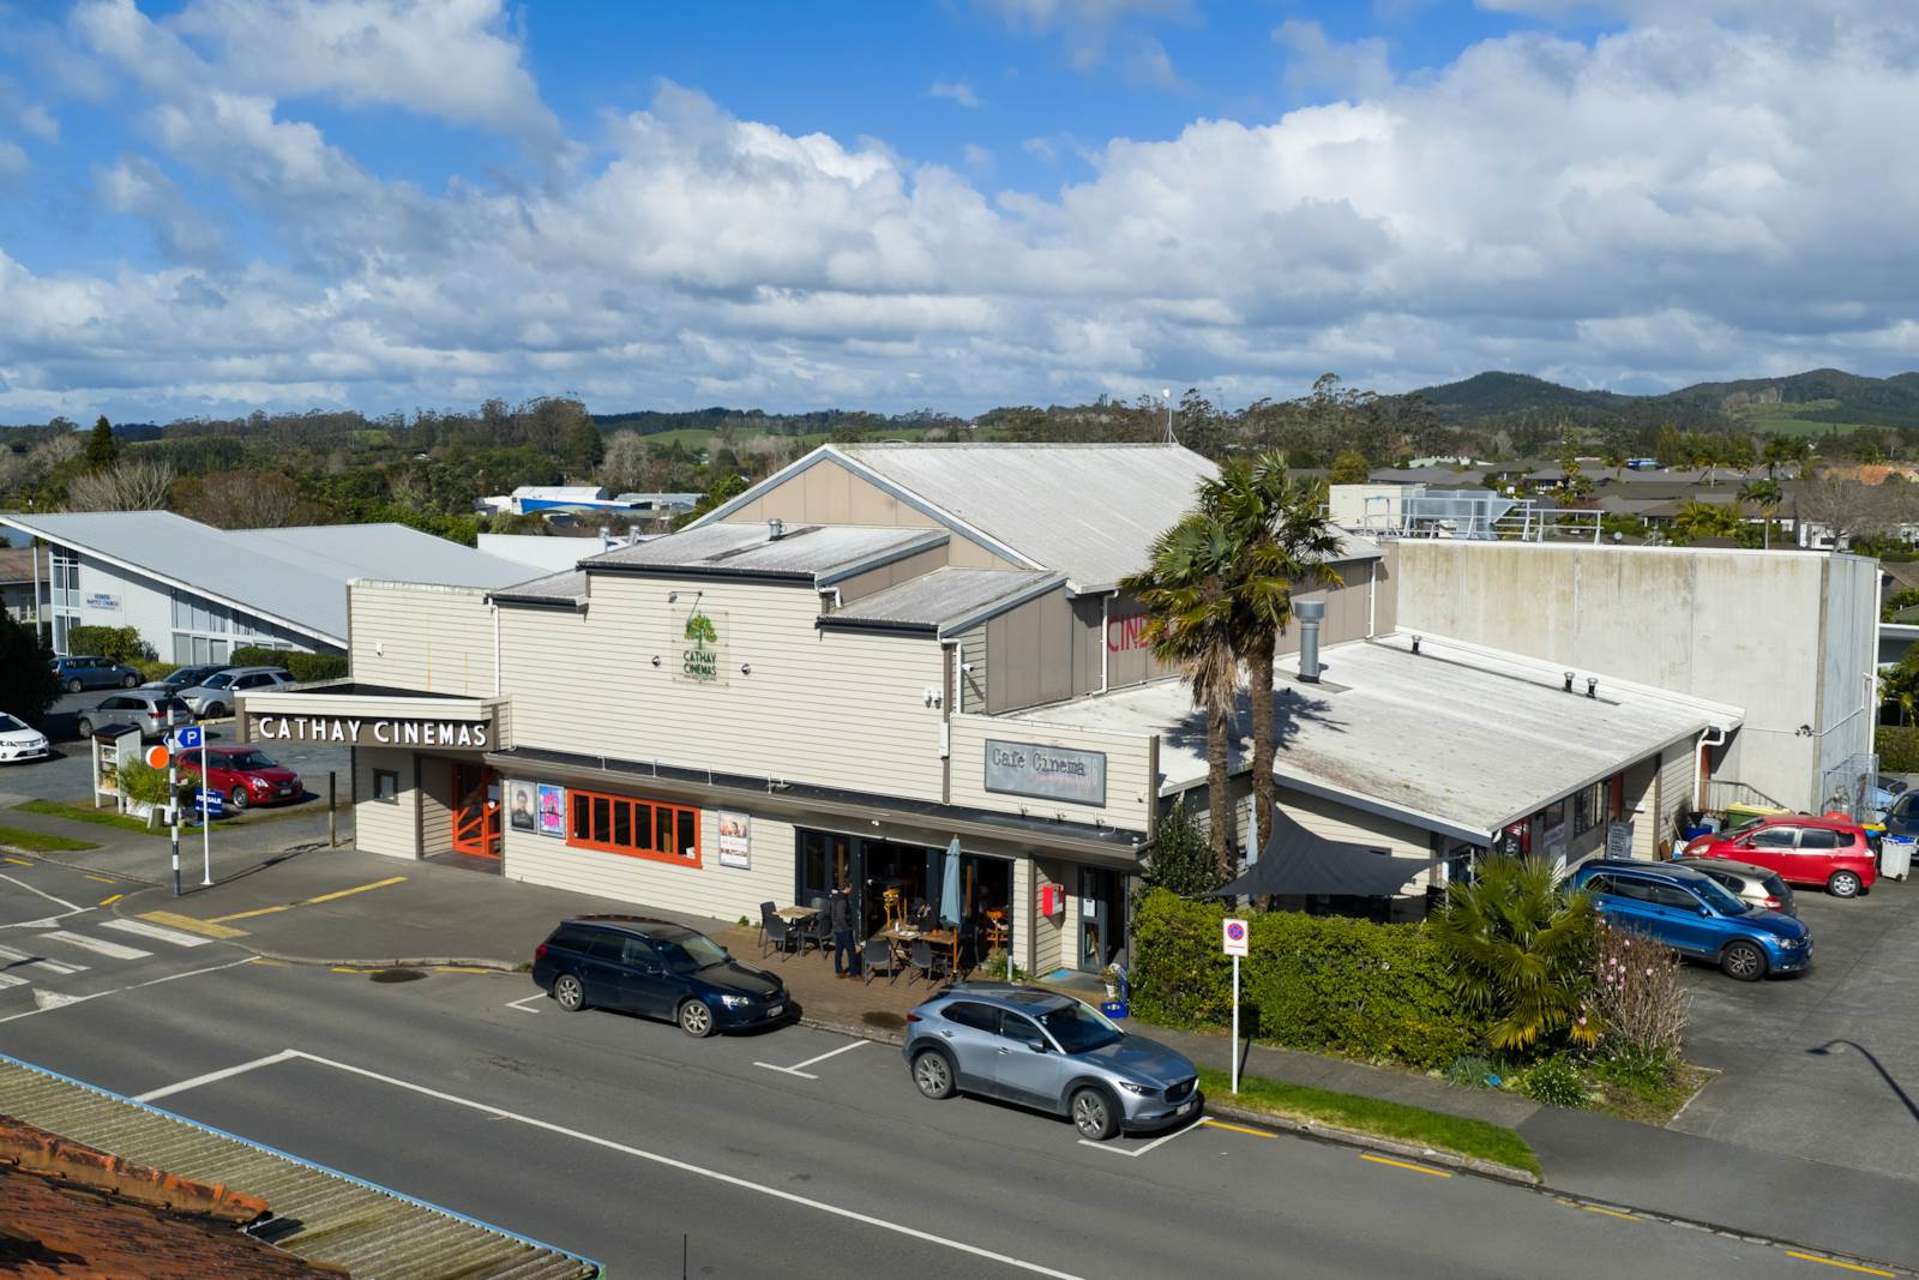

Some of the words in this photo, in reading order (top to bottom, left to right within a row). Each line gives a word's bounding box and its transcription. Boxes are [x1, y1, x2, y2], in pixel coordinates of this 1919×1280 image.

[683, 650, 717, 664] CATHAY
[683, 662, 717, 676] CINEMAS
[187, 731, 198, 745] P
[258, 716, 362, 743] CATHAY
[373, 720, 488, 747] CINEMAS
[992, 747, 1026, 769] Cafe
[1032, 752, 1086, 776] Cinema
